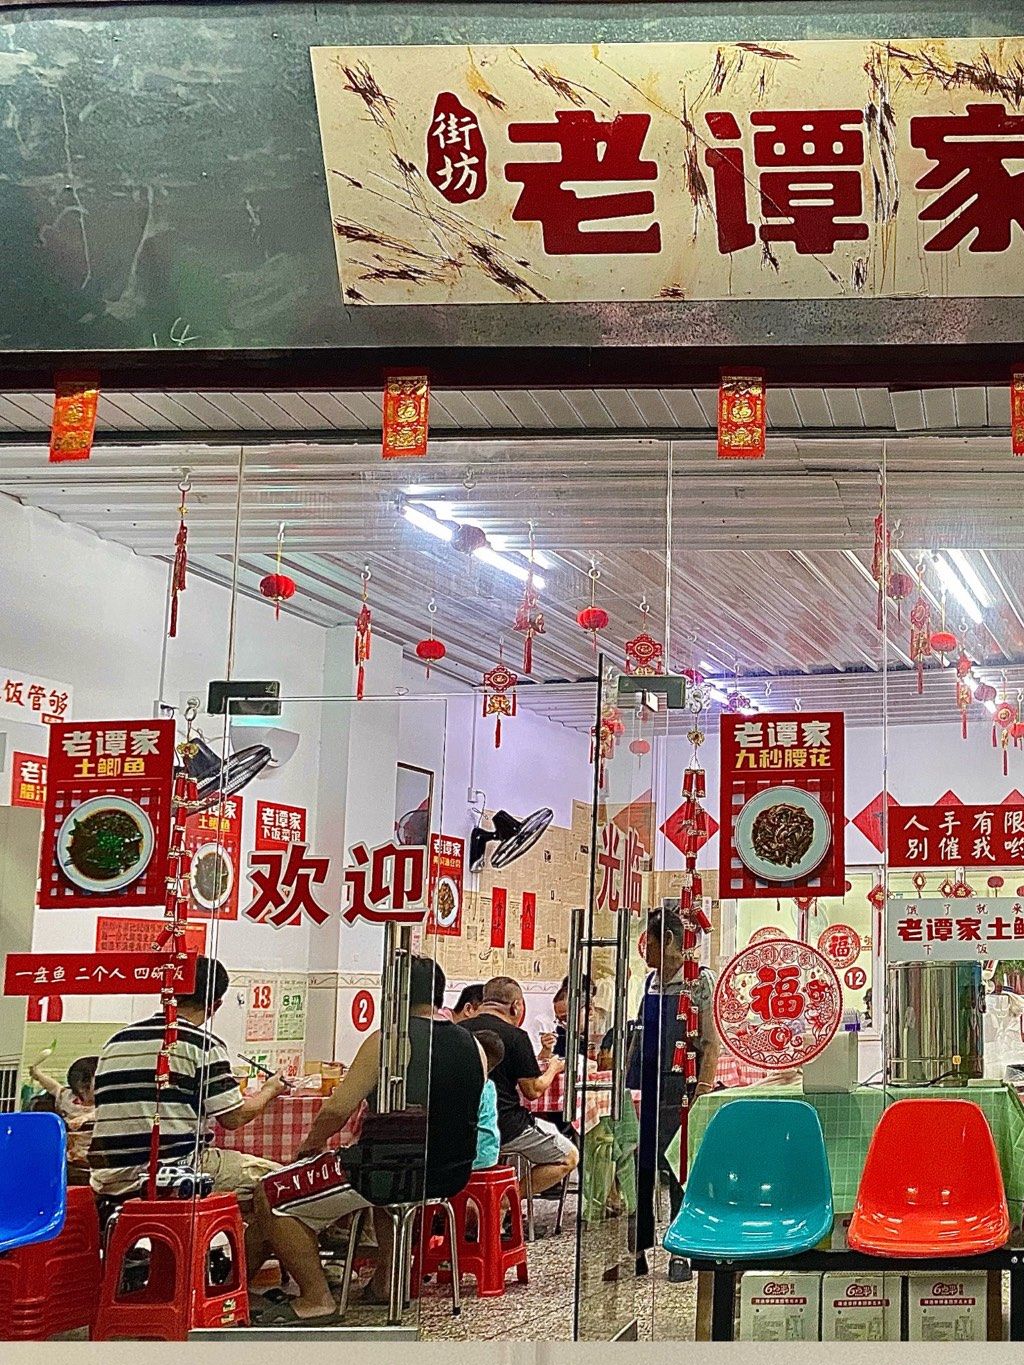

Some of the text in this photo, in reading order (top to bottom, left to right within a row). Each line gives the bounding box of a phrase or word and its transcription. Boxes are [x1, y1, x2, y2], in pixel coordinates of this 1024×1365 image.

[430, 112, 478, 196] 街坊
[62, 729, 161, 757] 老谭家
[734, 721, 832, 749] 老谭家
[74, 757, 146, 778] 土鲫鱼
[734, 749, 831, 769] 九秒腰花
[20, 761, 47, 784] 老
[261, 807, 302, 830] 老谭家
[260, 825, 302, 842] 下饭菜馆
[433, 839, 461, 857] 老谭家
[597, 823, 644, 917] 光临
[246, 842, 427, 926] 欢迎
[829, 935, 851, 957] 福
[15, 966, 66, 983] 一盘鱼
[75, 966, 127, 981] 二个人
[847, 972, 865, 985] 12
[252, 985, 272, 1009] 13
[751, 965, 805, 1021] 福
[37, 995, 51, 1023] 1
[358, 998, 368, 1024] 2
